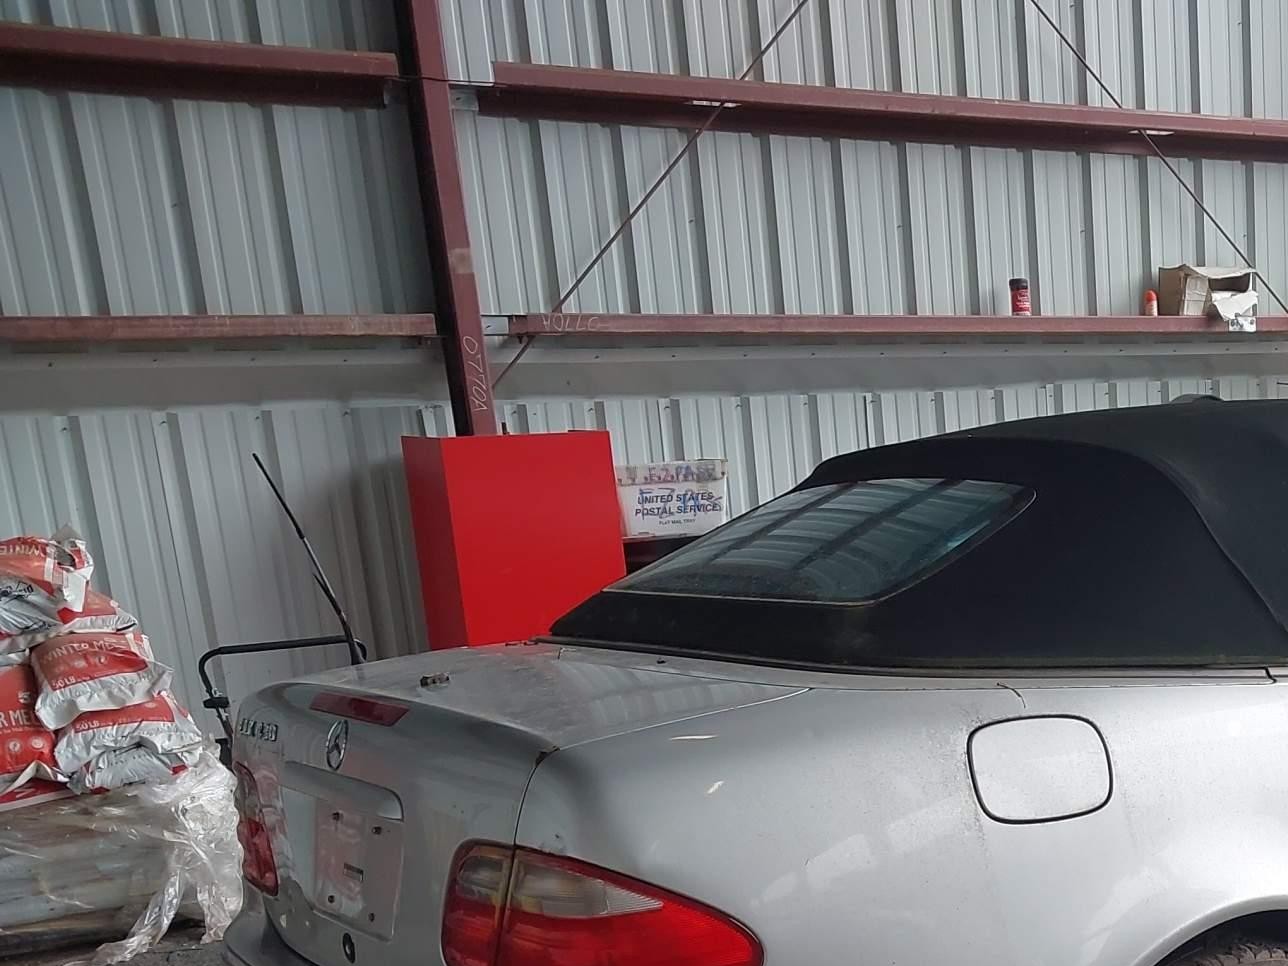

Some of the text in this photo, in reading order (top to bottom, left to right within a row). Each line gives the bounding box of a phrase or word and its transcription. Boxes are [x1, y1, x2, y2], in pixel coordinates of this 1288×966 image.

[637, 491, 714, 505] UNITED STATES
[634, 503, 719, 517] POSTAL SERVICE
